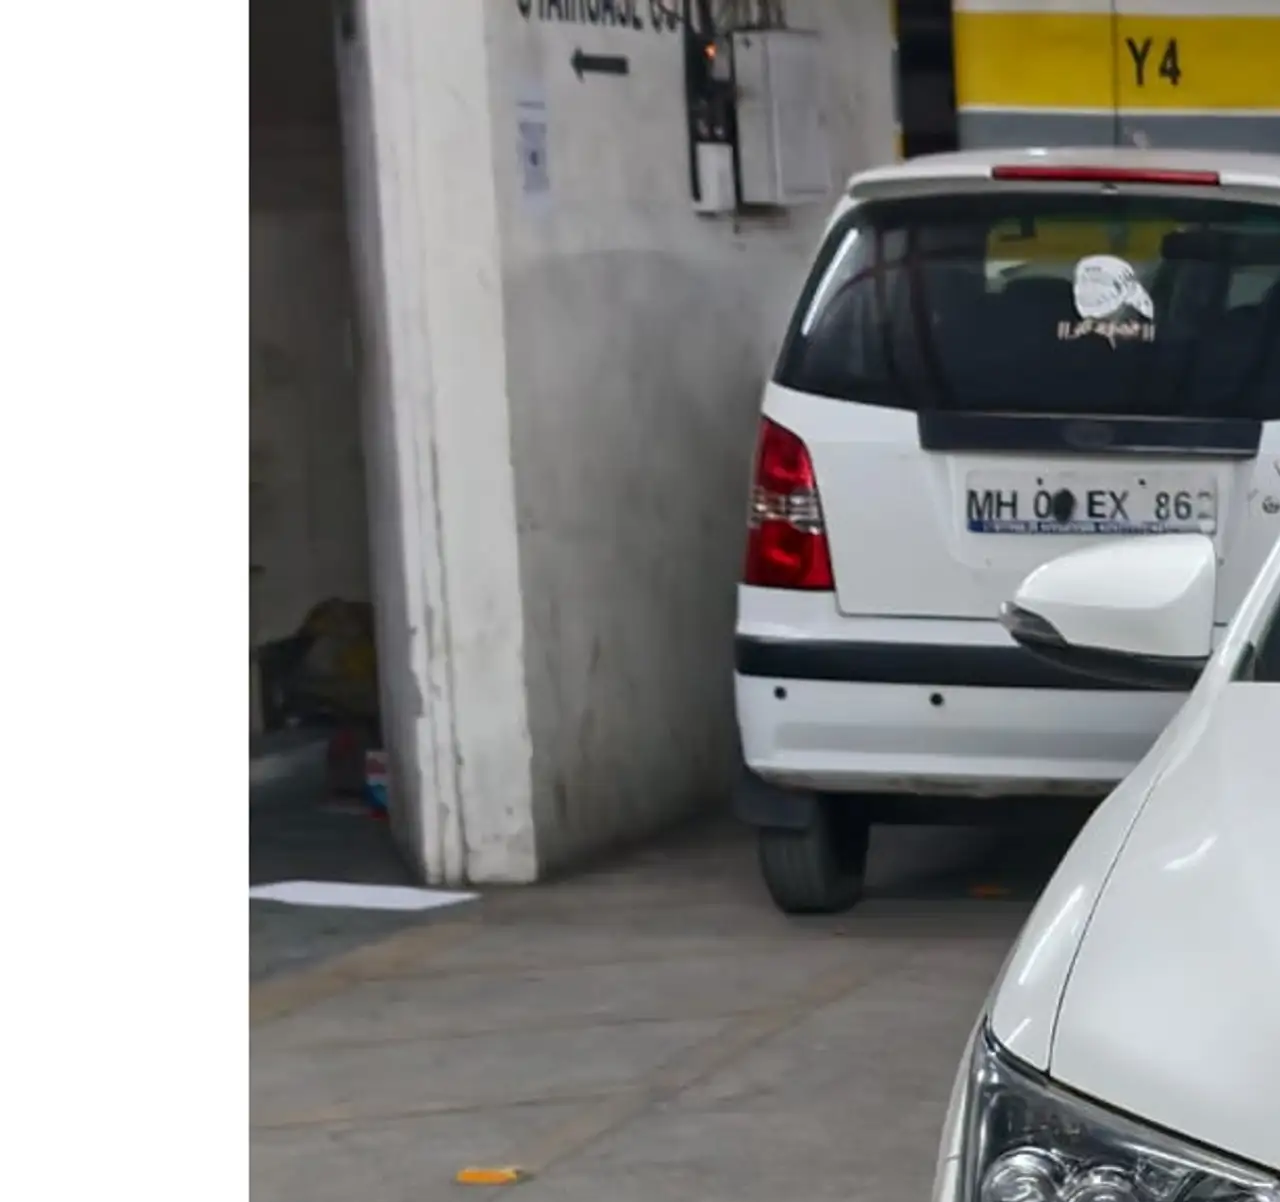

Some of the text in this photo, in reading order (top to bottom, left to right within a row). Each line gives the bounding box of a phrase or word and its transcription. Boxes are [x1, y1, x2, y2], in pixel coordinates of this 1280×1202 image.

[1126, 37, 1181, 87] Y4
[967, 490, 1018, 520] MH
[1034, 488, 1077, 523] 0
[1087, 490, 1129, 520] EX
